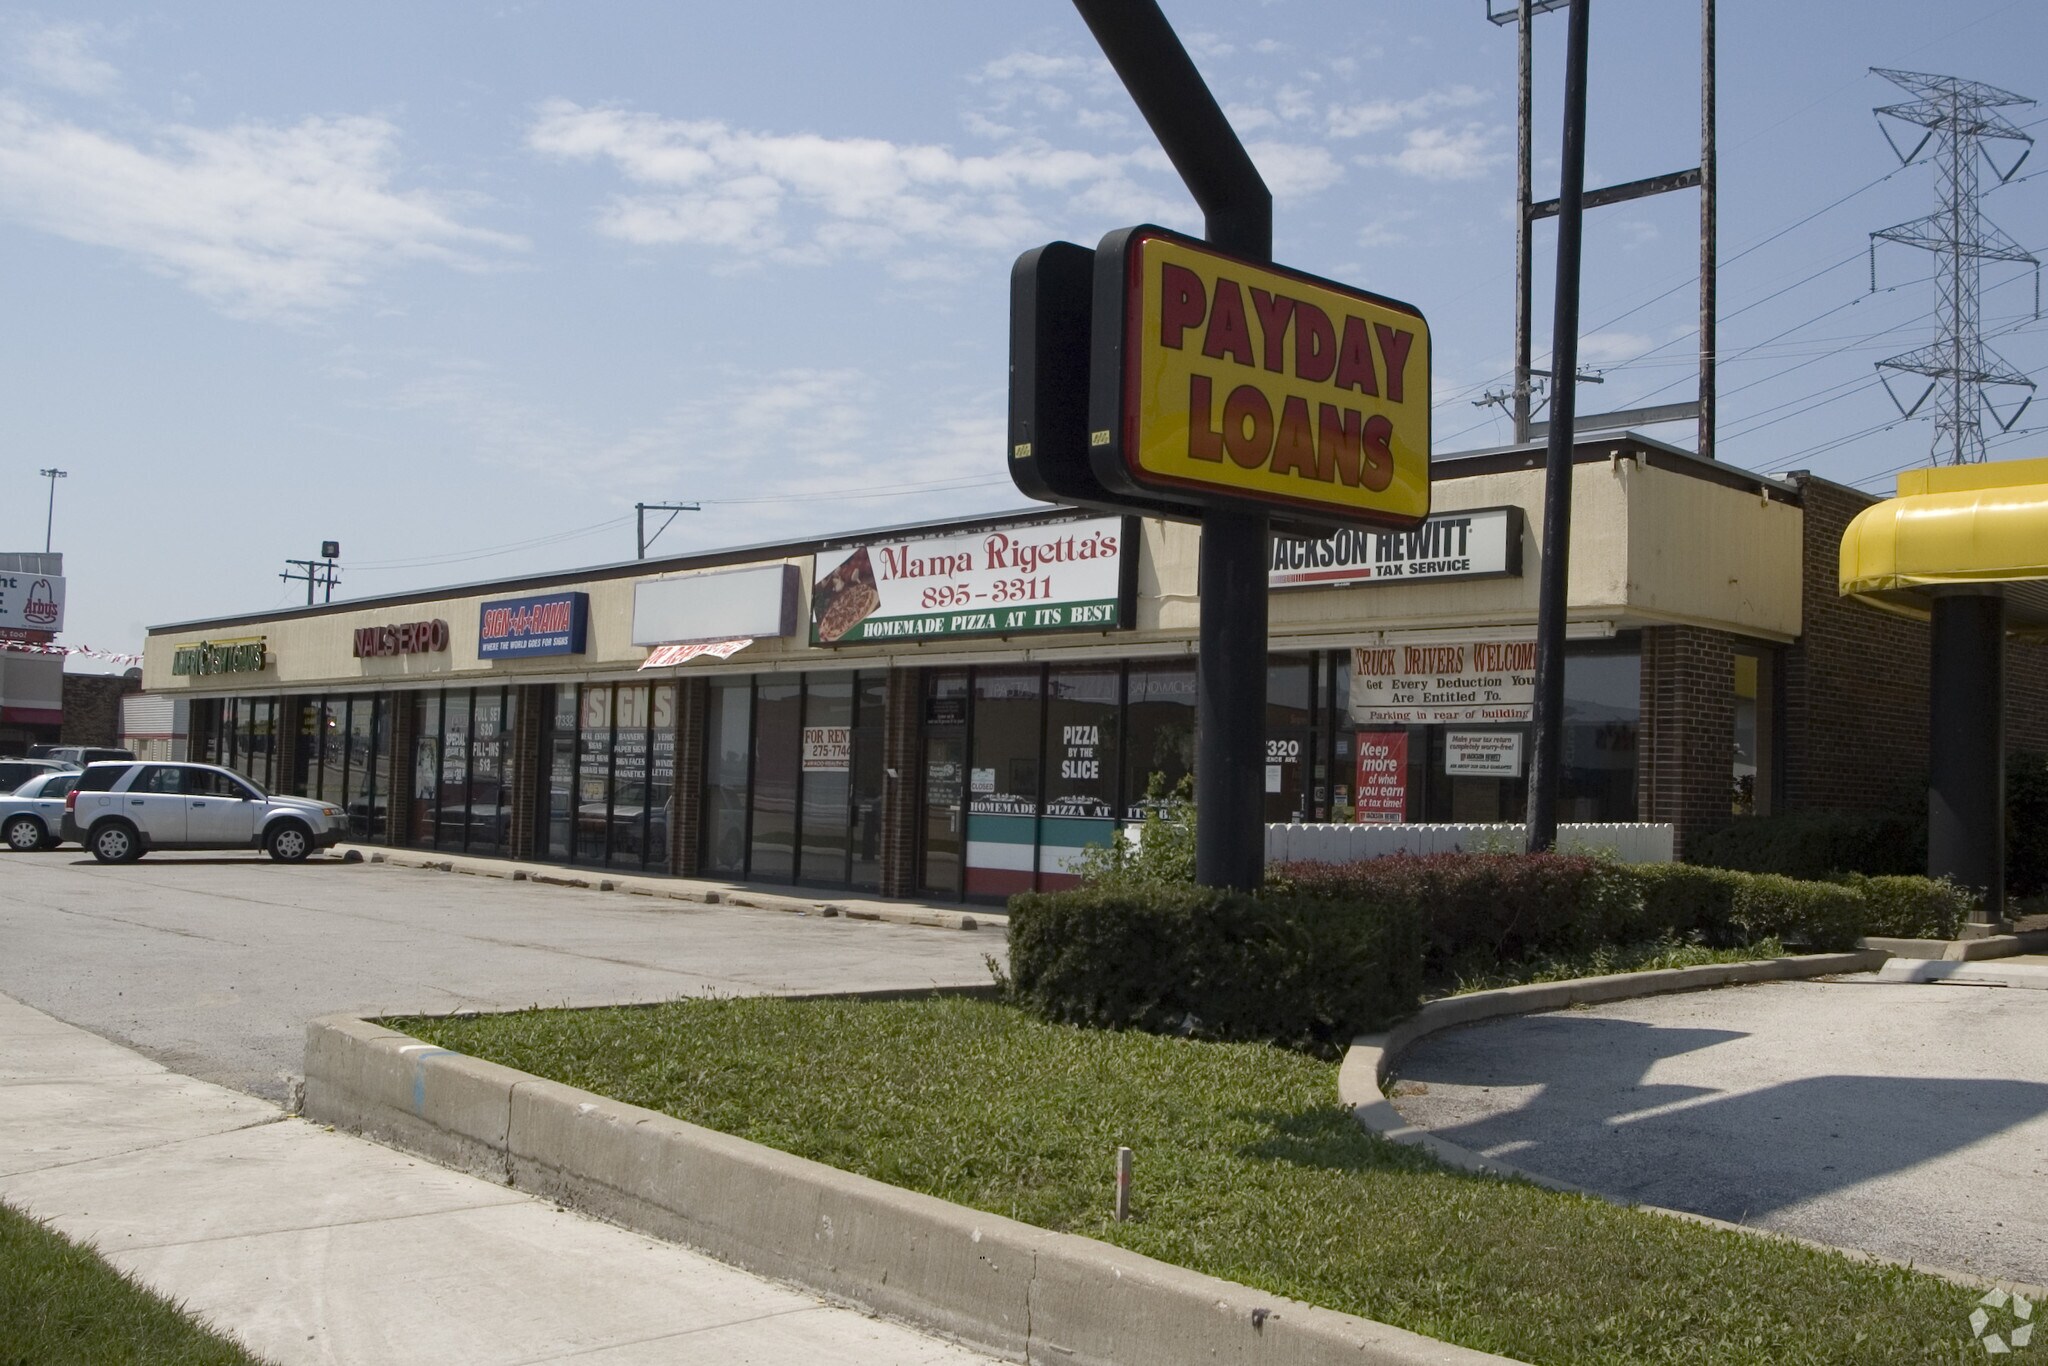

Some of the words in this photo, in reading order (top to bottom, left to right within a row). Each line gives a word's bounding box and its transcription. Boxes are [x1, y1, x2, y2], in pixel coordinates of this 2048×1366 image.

[1160, 260, 1414, 404] PAYDAY
[1187, 373, 1394, 492] LOANS
[1375, 518, 1471, 563] HEWITT
[880, 544, 973, 581] Mama
[983, 531, 1119, 574] Rigetta's
[1375, 564, 1403, 578] TAX
[1409, 559, 1470, 575] SERVICE
[921, 575, 1053, 609] 895-3311
[23, 598, 58, 619] Arby's
[862, 618, 945, 638] HOMEMADE
[950, 613, 996, 632] PIZZA
[1004, 611, 1027, 627] AT
[1034, 608, 1062, 626] ITS
[1070, 604, 1114, 624] BEST
[354, 624, 397, 657] NAILS
[398, 618, 446, 654] EXPO
[482, 642, 499, 651] WHERE
[499, 641, 509, 650] THE
[510, 640, 527, 650] WORLD
[527, 639, 541, 648] GOES
[541, 638, 552, 647] FOR
[552, 636, 569, 646] SIGNS
[1355, 646, 1396, 676] TRUCK
[1404, 645, 1464, 675] DRIVERS
[1473, 641, 1537, 672] WELCOM
[1129, 679, 1196, 695] SANDWICHE
[1366, 678, 1383, 690] Get
[1391, 677, 1428, 692] Every
[1436, 675, 1502, 689] Deduction
[1511, 674, 1535, 687] You
[1392, 692, 1414, 703] Are
[1422, 691, 1476, 703] Entitled
[1483, 690, 1502, 702] To.
[475, 706, 488, 721] FULL
[489, 706, 501, 721] SET
[588, 685, 671, 727] SIGNS
[554, 713, 574, 727] 17332
[1369, 710, 1411, 722] Parking
[1417, 709, 1427, 720] in
[1434, 710, 1459, 720] rear
[1465, 709, 1475, 720] of
[1481, 707, 1529, 721] building
[618, 733, 645, 741] BANNERS
[657, 733, 675, 741] VEHIC
[805, 729, 824, 744] FOR
[1063, 725, 1099, 745] PIZZA
[1469, 736, 1482, 744] your
[473, 742, 499, 757] FILL-INS
[614, 745, 632, 753] PAPER
[653, 742, 674, 751] LETTER
[1067, 747, 1078, 758] BY
[1080, 747, 1093, 758] THE
[1266, 740, 1299, 756] 320
[1360, 742, 1389, 760] Keep
[1449, 743, 1480, 752] completely
[629, 758, 645, 766] FACES
[1062, 760, 1099, 779] SLICE
[1362, 758, 1398, 772] more
[615, 769, 645, 778] MAGNETICS
[652, 769, 673, 777] LETTER
[1368, 774, 1378, 784] of
[1378, 774, 1398, 785] what
[971, 782, 994, 792] CLOSED
[1358, 786, 1378, 800] you
[1380, 786, 1404, 797] earn
[970, 801, 1036, 815] HOMEMADE
[1046, 804, 1085, 817] PIZZA
[1093, 806, 1111, 818] AT
[1358, 798, 1367, 807] at
[1369, 799, 1381, 807] tax
[1383, 797, 1403, 808] time!
